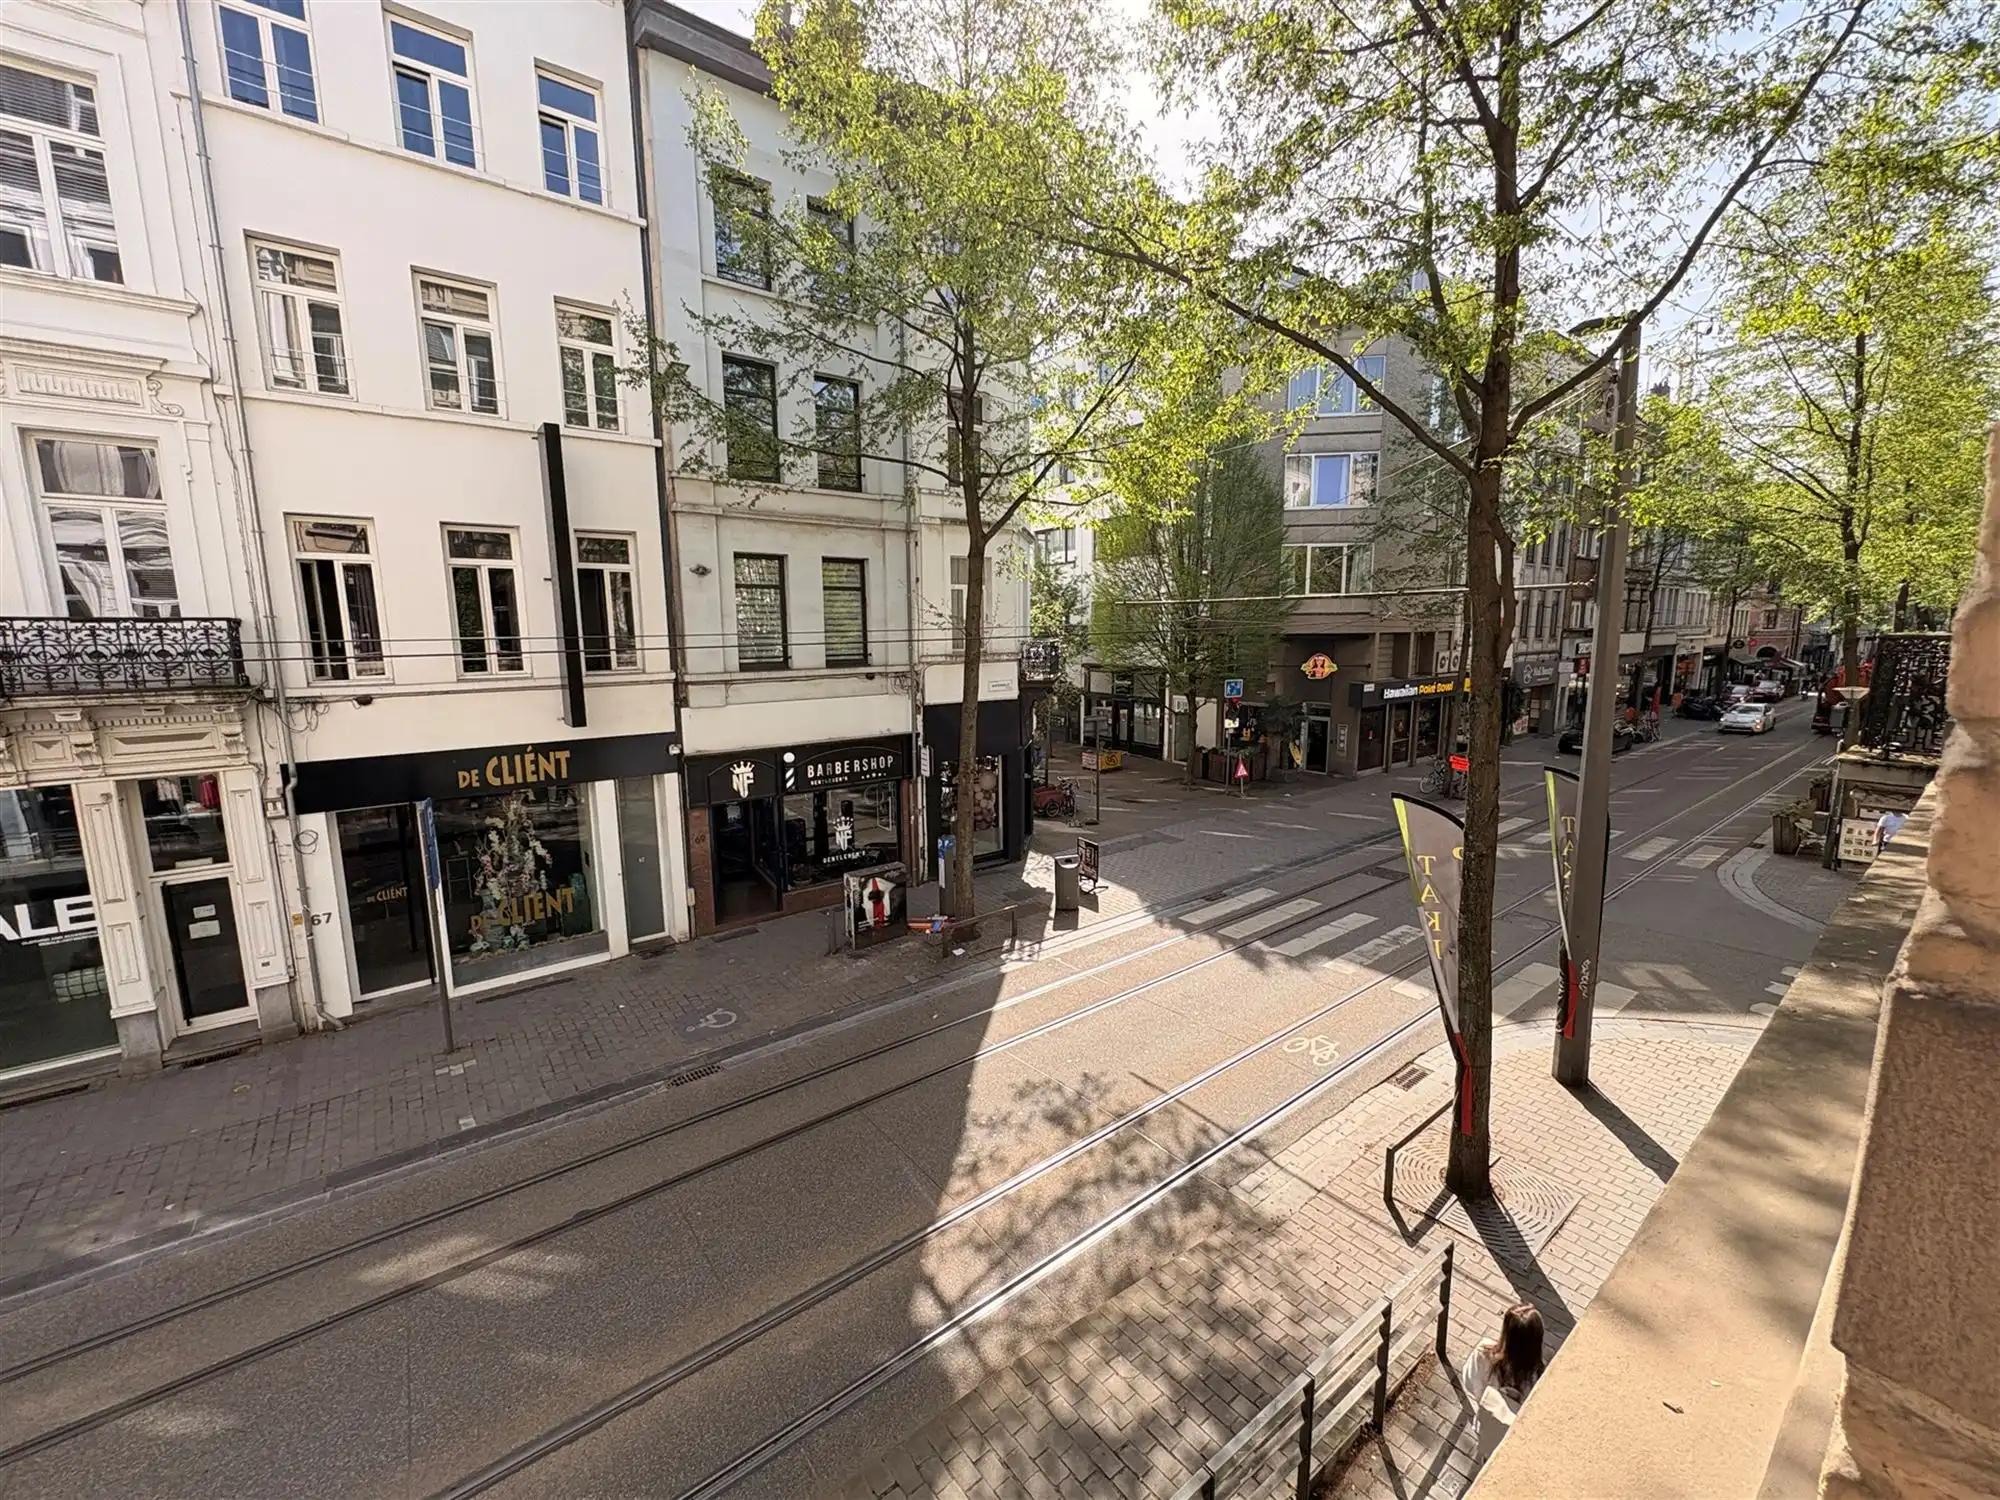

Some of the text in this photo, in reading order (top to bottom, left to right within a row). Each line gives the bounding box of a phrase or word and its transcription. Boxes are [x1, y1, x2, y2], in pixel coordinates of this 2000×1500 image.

[457, 745, 570, 788] DE CLIÉNT
[807, 755, 894, 778] BARBERSHOP
[311, 911, 333, 926] 67
